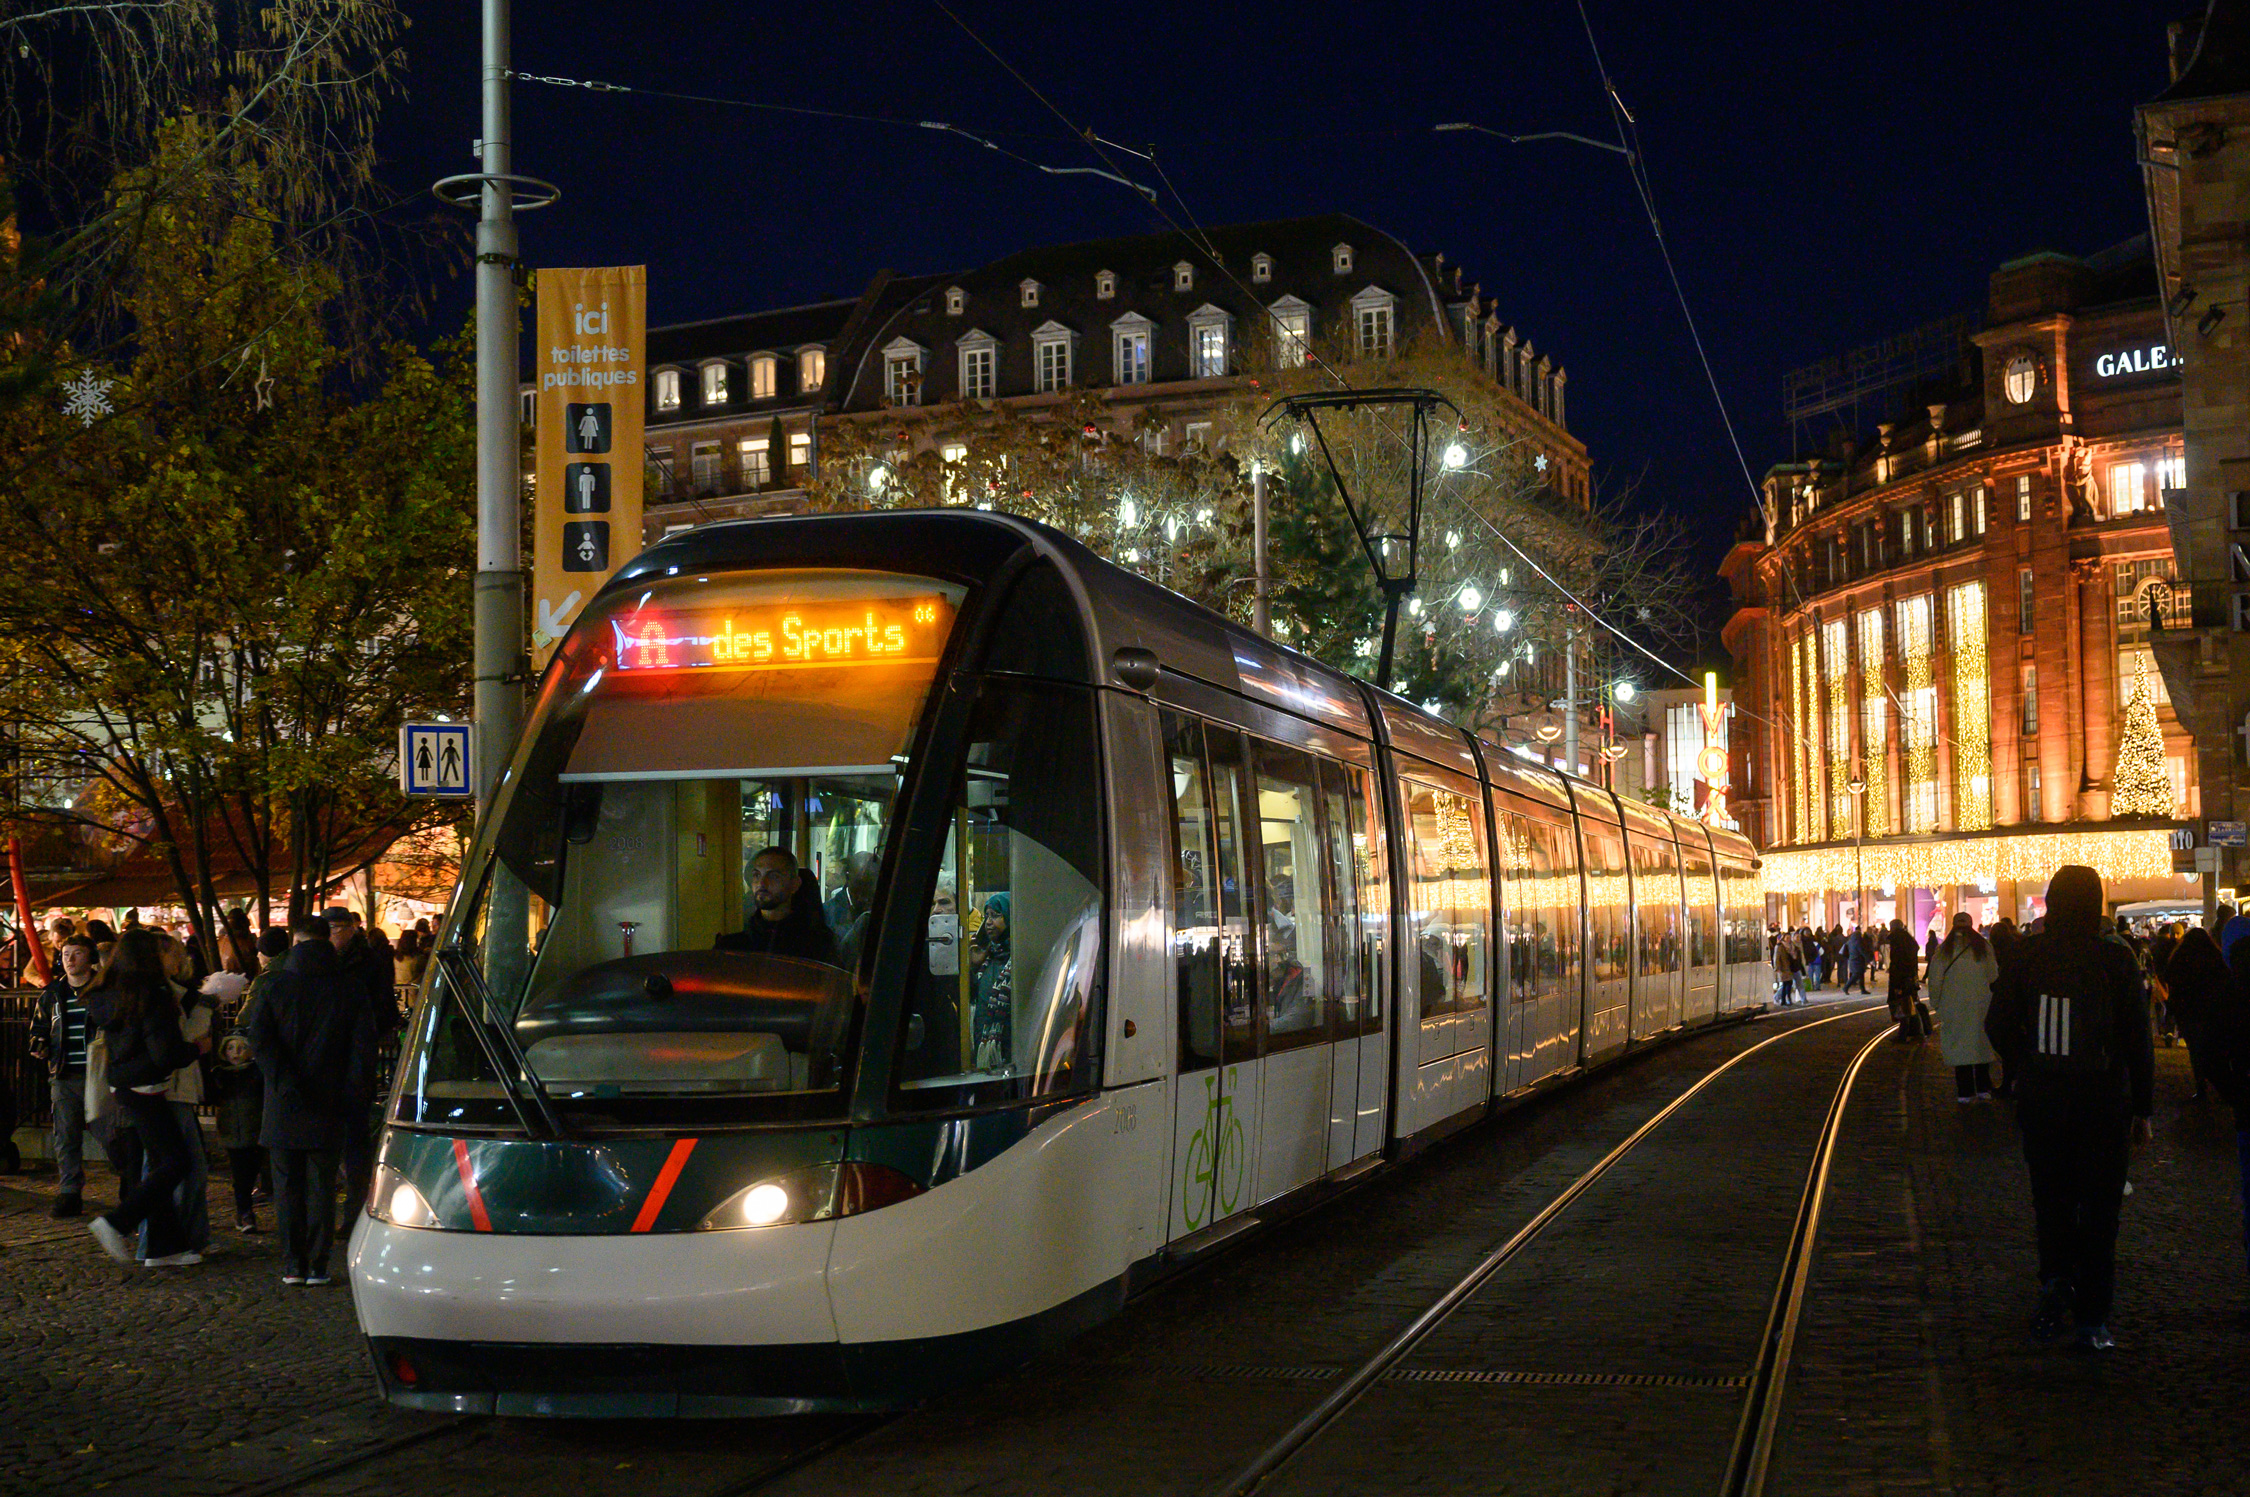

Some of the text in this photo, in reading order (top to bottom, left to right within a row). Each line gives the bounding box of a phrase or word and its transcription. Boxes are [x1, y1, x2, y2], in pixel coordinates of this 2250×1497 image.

[575, 302, 608, 335] ici
[551, 345, 630, 364] toilettes
[2097, 345, 2184, 377] GALE
[543, 366, 637, 391] publiques
[637, 605, 935, 666] A des Sports 06
[609, 836, 645, 850] 2008
